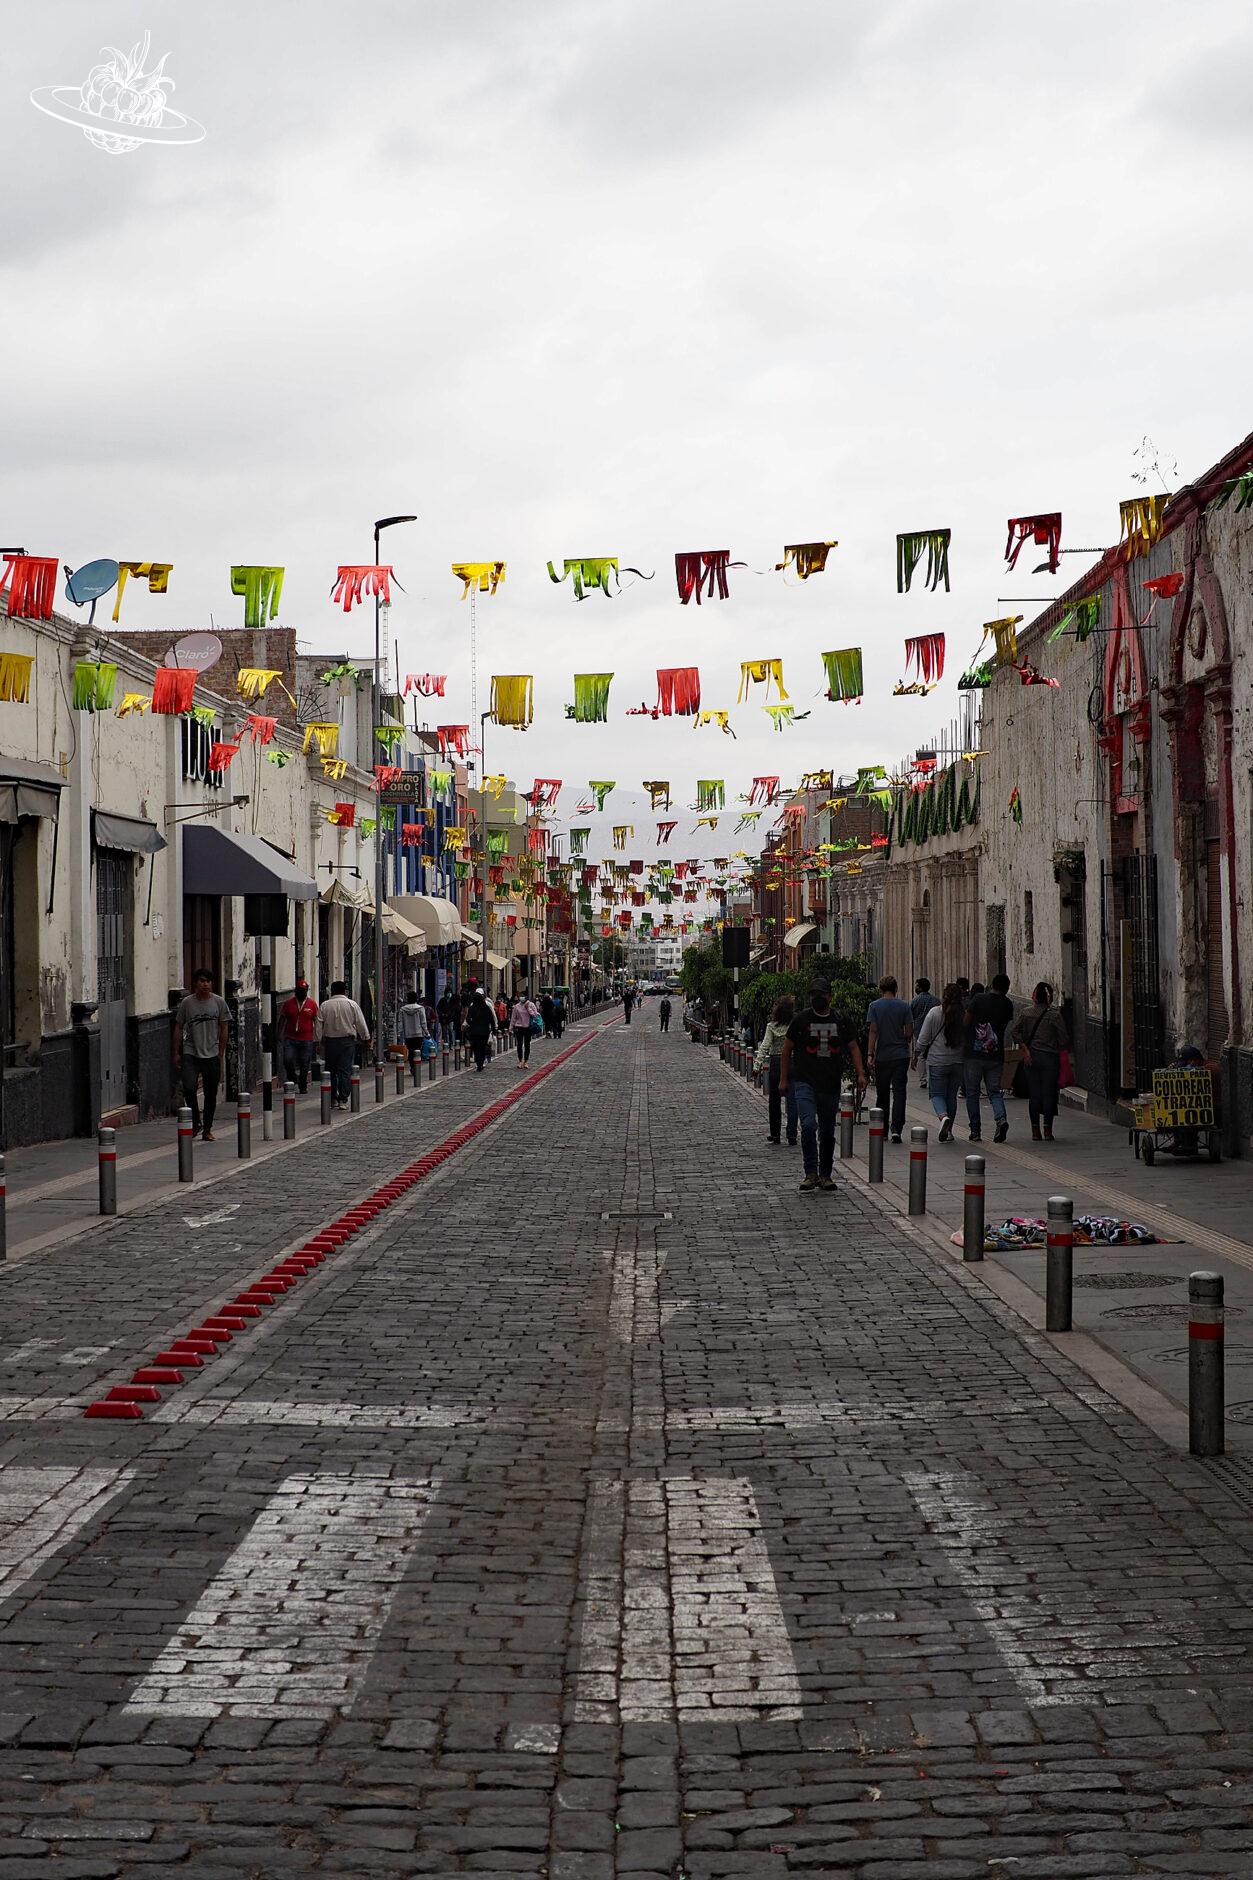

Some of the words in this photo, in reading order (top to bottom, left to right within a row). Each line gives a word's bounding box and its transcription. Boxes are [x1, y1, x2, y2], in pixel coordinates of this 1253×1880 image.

[176, 649, 209, 659] Claro
[390, 783, 411, 791] ORO
[1154, 1071, 1185, 1079] REVISTA
[1189, 1070, 1209, 1078] PARA
[1154, 1079, 1211, 1097] COLOREAR
[1155, 1099, 1161, 1109] Y
[1162, 1095, 1212, 1109] TRAZAR
